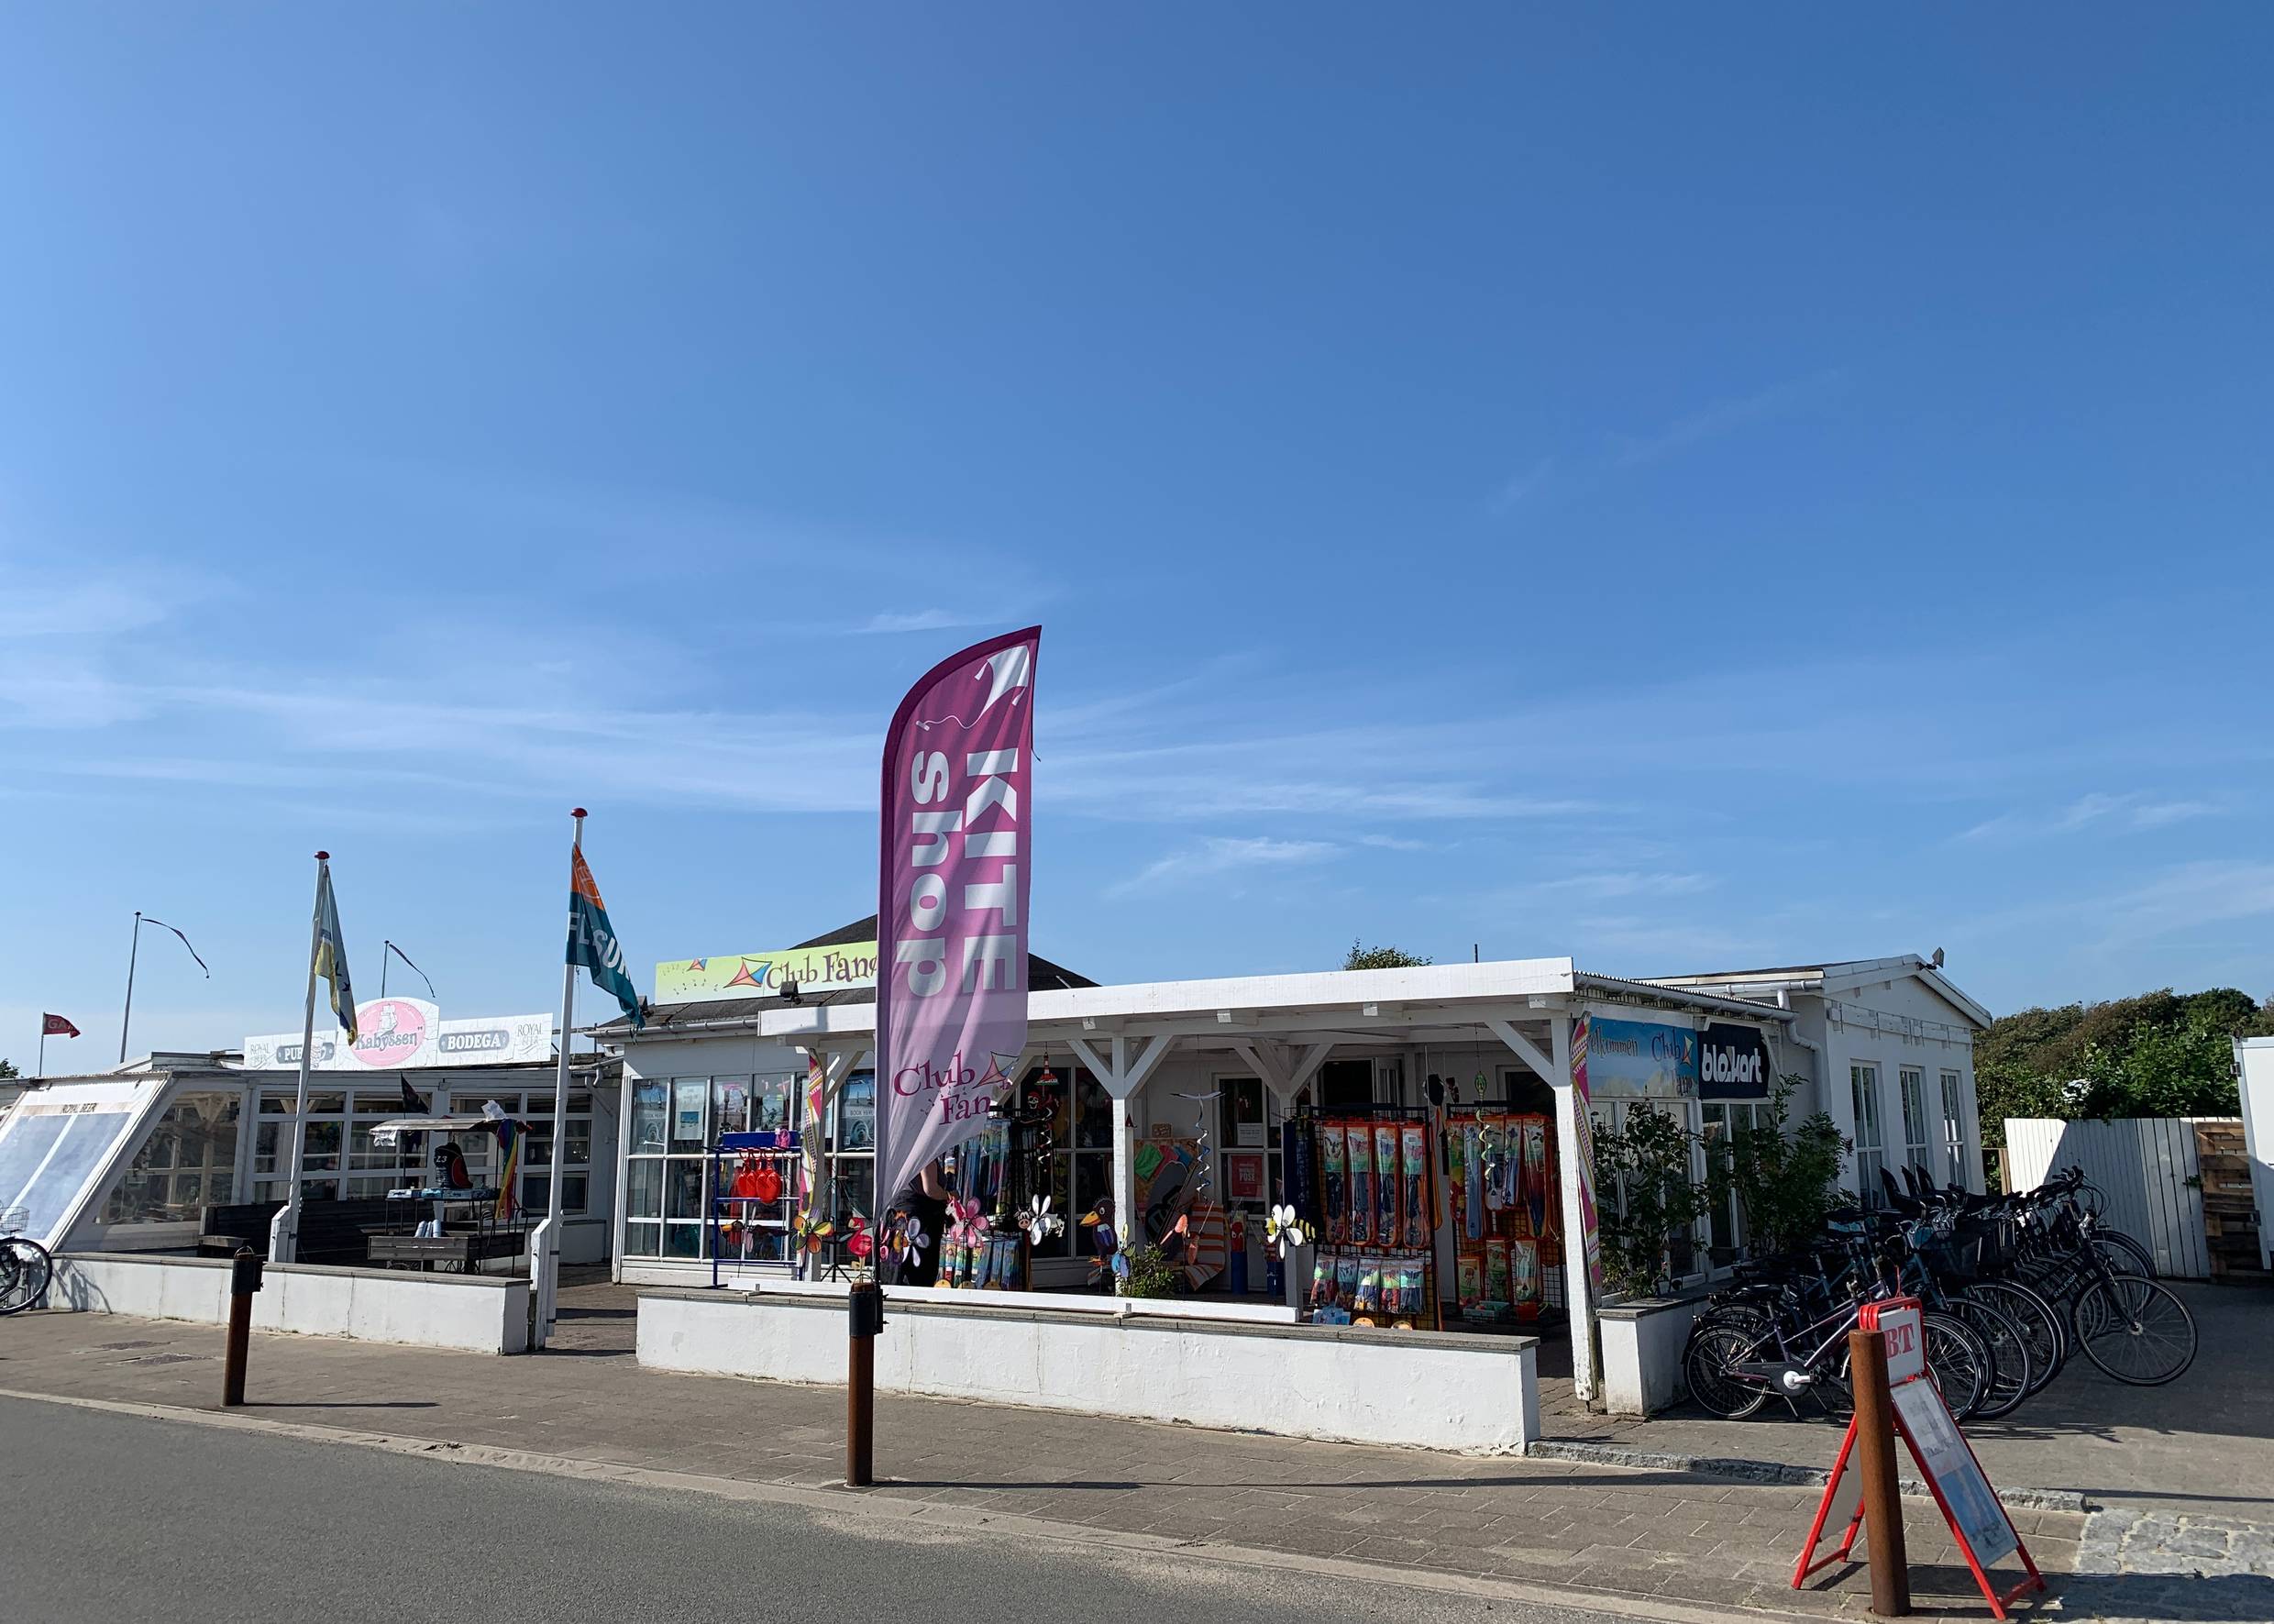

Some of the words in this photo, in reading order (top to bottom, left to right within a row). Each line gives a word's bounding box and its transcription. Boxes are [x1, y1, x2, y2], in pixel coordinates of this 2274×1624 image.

[896, 750, 963, 997] shop
[964, 747, 1019, 994] KITE
[766, 954, 818, 989] Club
[284, 1047, 303, 1061] PUB
[447, 1033, 502, 1051] BODEGA
[1651, 1028, 1682, 1062] Club
[893, 1050, 976, 1097] Club
[938, 1094, 991, 1126] Fan
